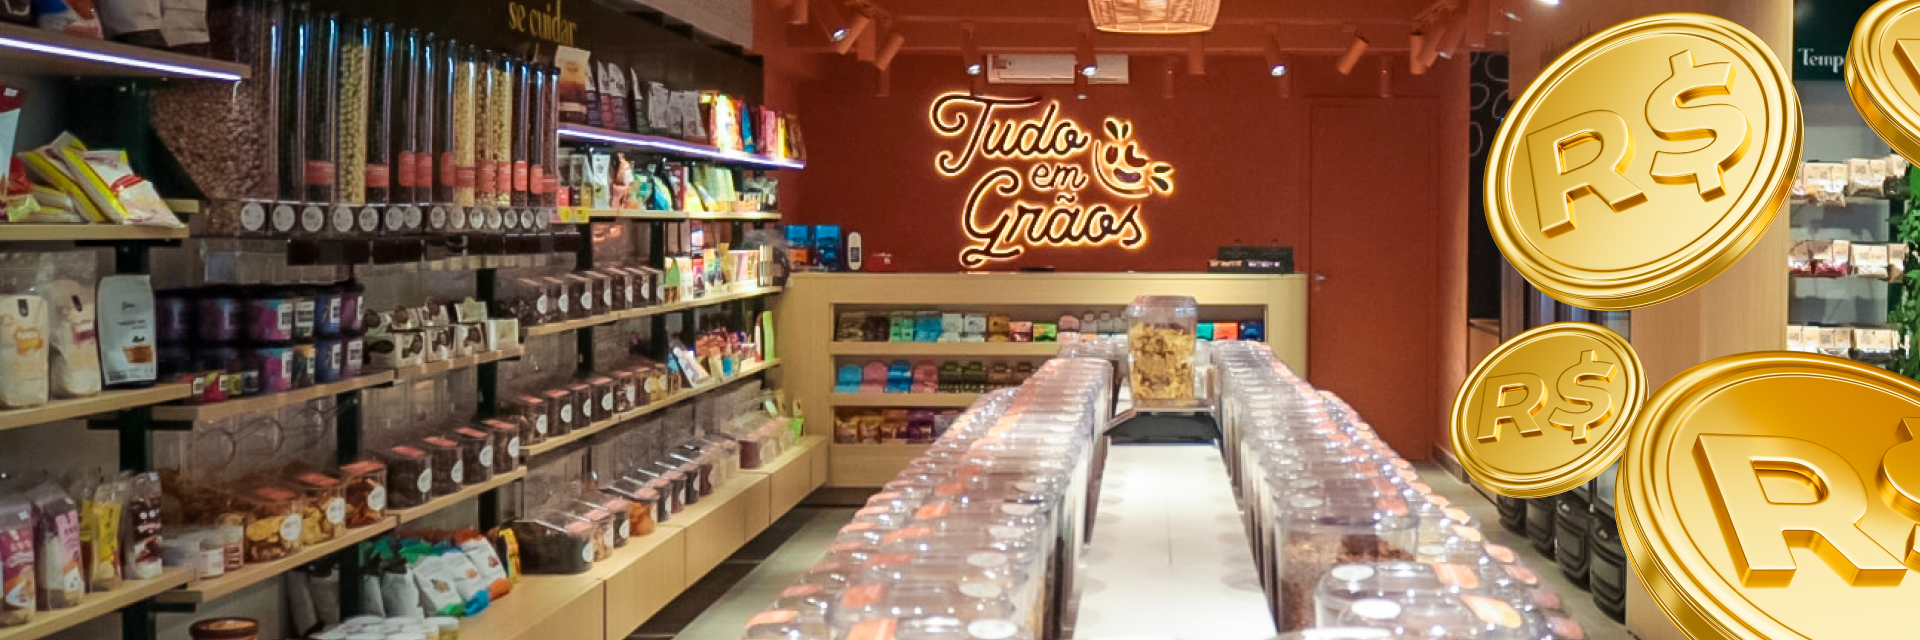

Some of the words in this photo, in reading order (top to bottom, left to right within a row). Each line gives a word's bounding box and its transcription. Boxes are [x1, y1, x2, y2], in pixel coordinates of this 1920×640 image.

[508, 1, 526, 33] se
[529, 0, 577, 46] cuidar
[931, 92, 1090, 175] Tudo
[1031, 163, 1088, 190] em
[961, 169, 1146, 266] Grãos
